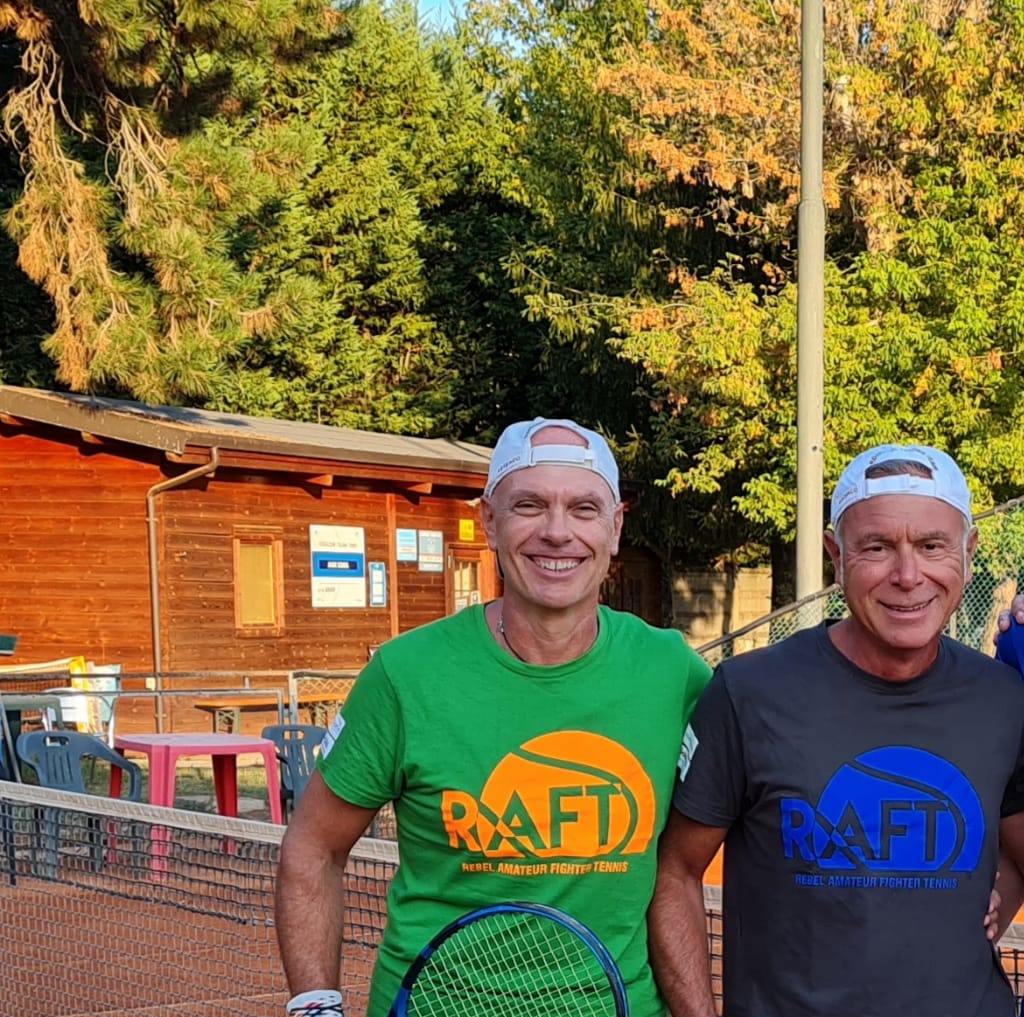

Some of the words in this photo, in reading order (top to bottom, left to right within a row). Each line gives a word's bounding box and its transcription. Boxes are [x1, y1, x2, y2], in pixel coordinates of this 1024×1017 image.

[440, 782, 623, 853] RAFT
[779, 796, 950, 863] RAFT
[461, 861, 495, 873] REBEL
[497, 862, 548, 876] AMATEUR
[593, 860, 629, 874] TENNIS
[828, 875, 877, 888] AMATEUR
[879, 876, 921, 889] FIGHTER
[923, 877, 958, 889] TENNIS
